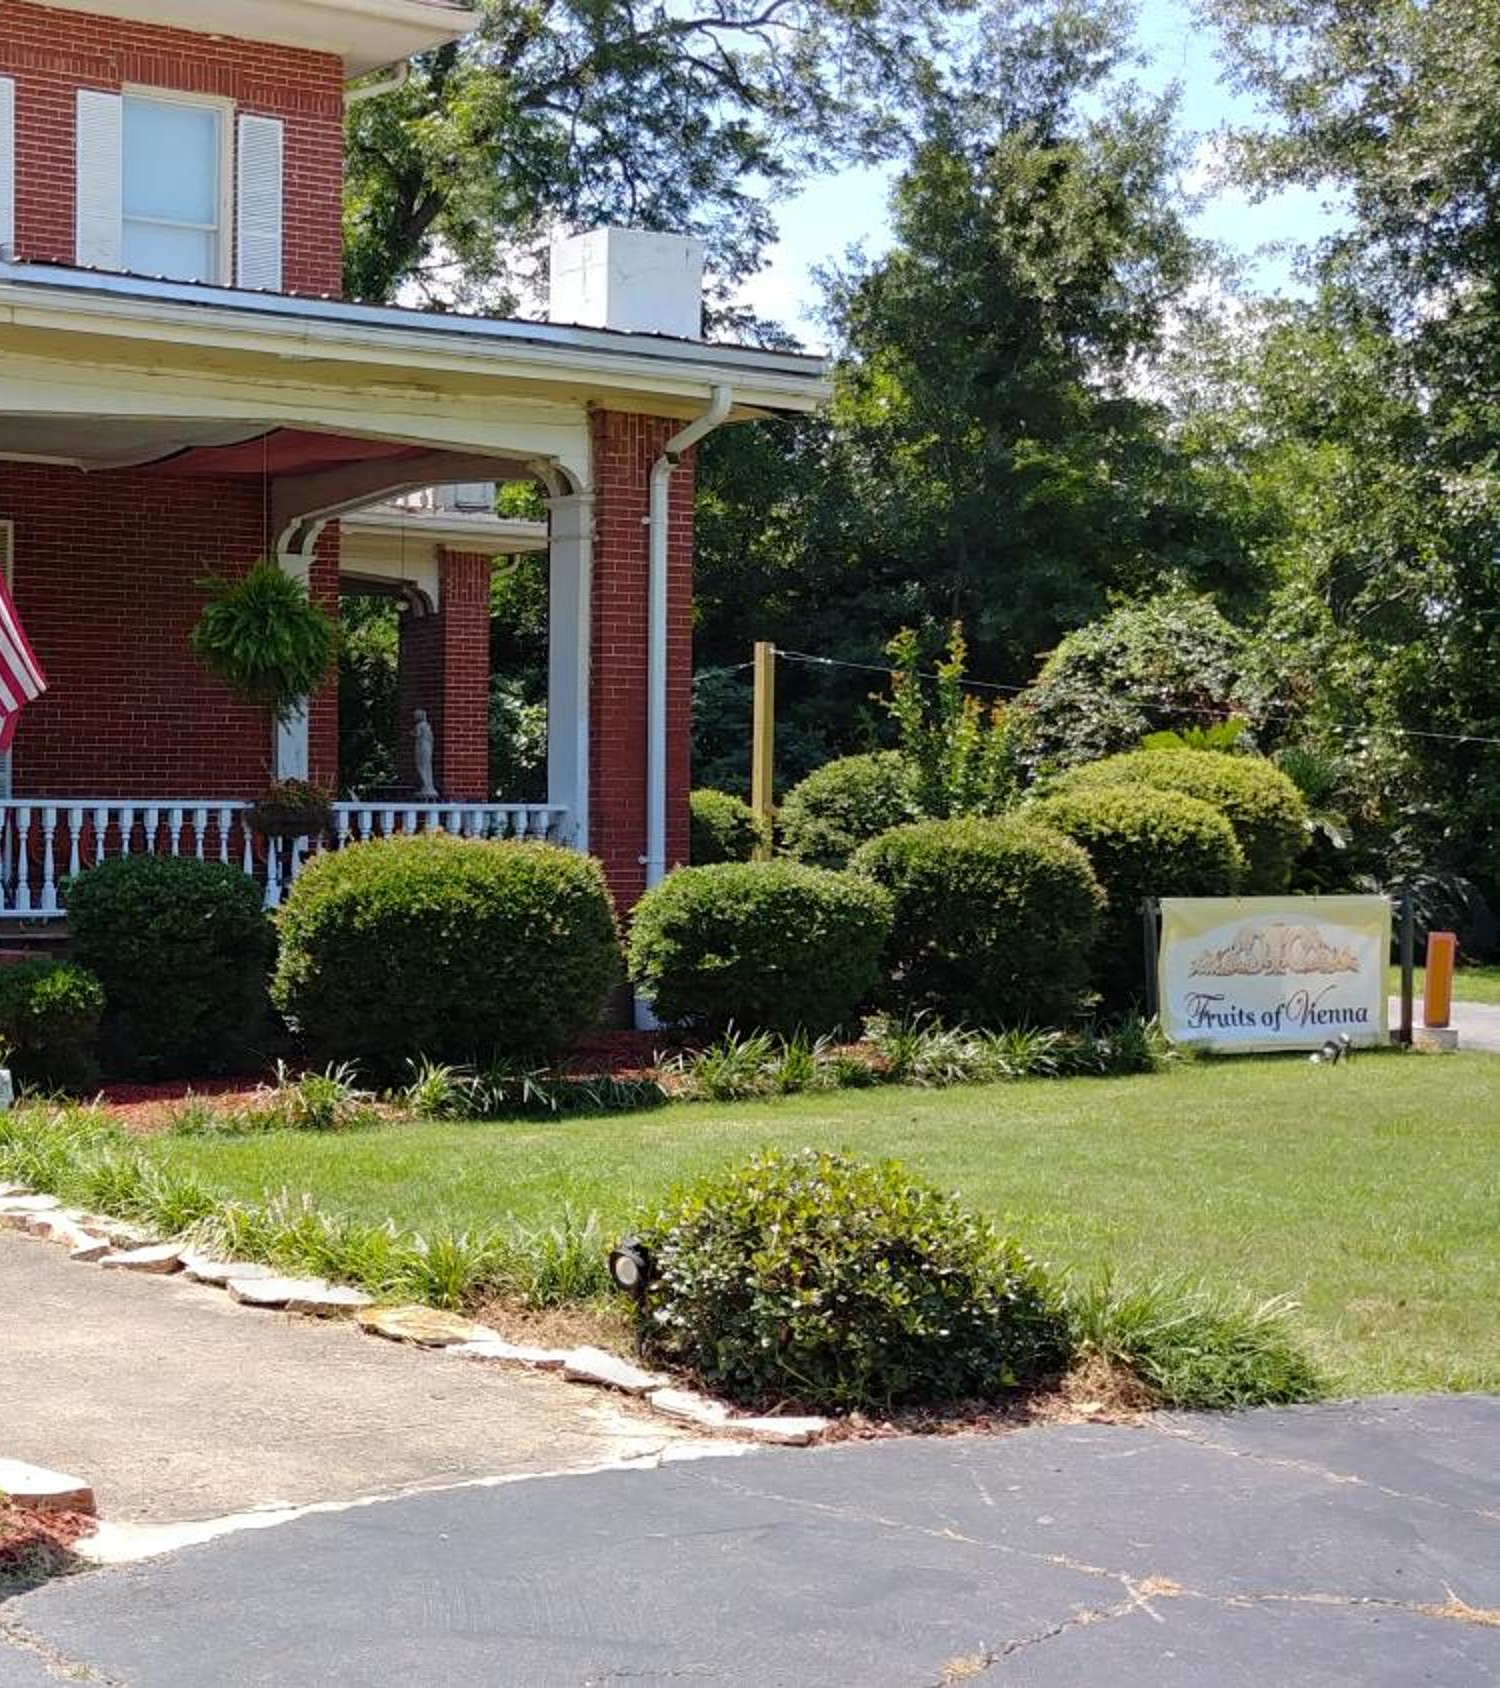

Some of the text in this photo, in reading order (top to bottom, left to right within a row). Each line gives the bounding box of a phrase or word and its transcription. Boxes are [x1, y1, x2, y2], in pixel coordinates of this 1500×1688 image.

[1186, 984, 1369, 1032] Fruits of Vienna
